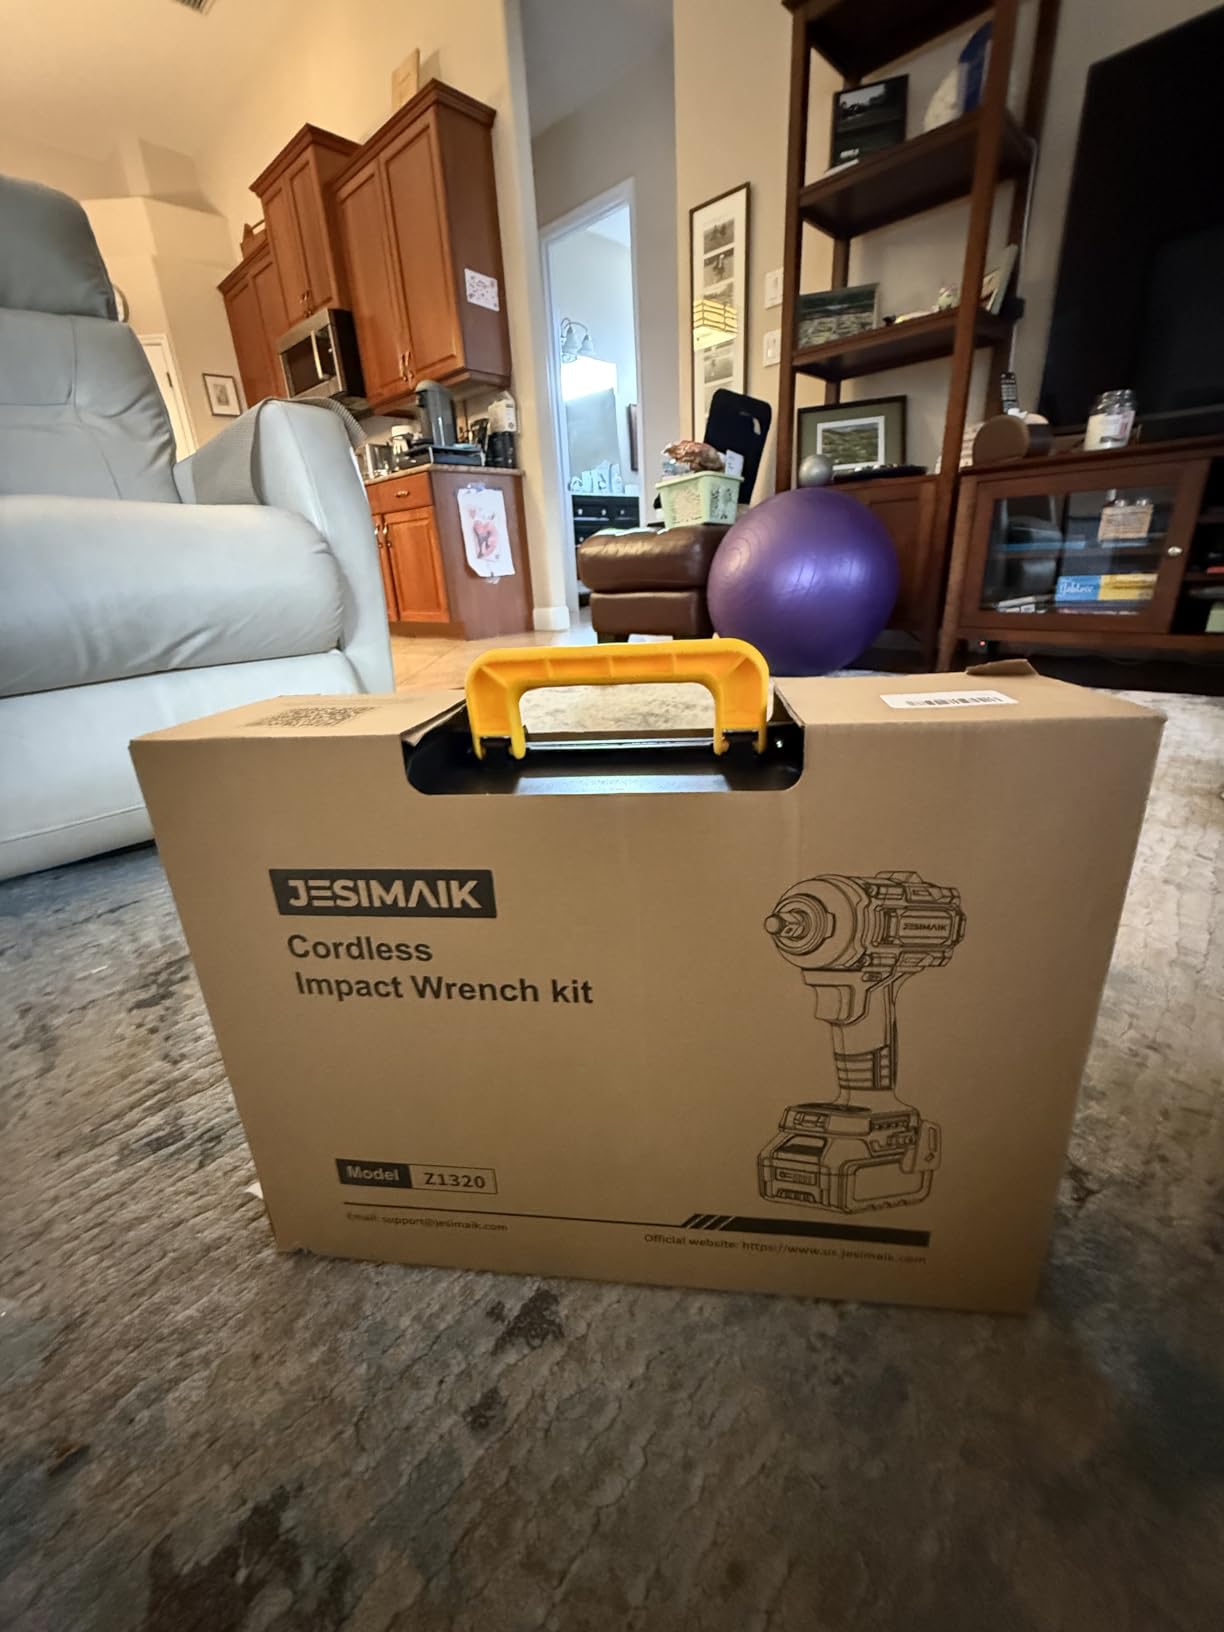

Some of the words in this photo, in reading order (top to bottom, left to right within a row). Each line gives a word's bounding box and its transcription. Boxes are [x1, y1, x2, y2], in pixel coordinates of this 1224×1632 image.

[287, 878, 483, 909] JESIMAIK
[287, 934, 434, 962] Cordless
[295, 971, 404, 1001] Impact
[410, 975, 540, 1003] Wrench
[551, 978, 595, 1004] kit
[346, 1165, 401, 1182] Model
[423, 1171, 487, 1190] Z1320
[644, 1233, 687, 1246] Official
